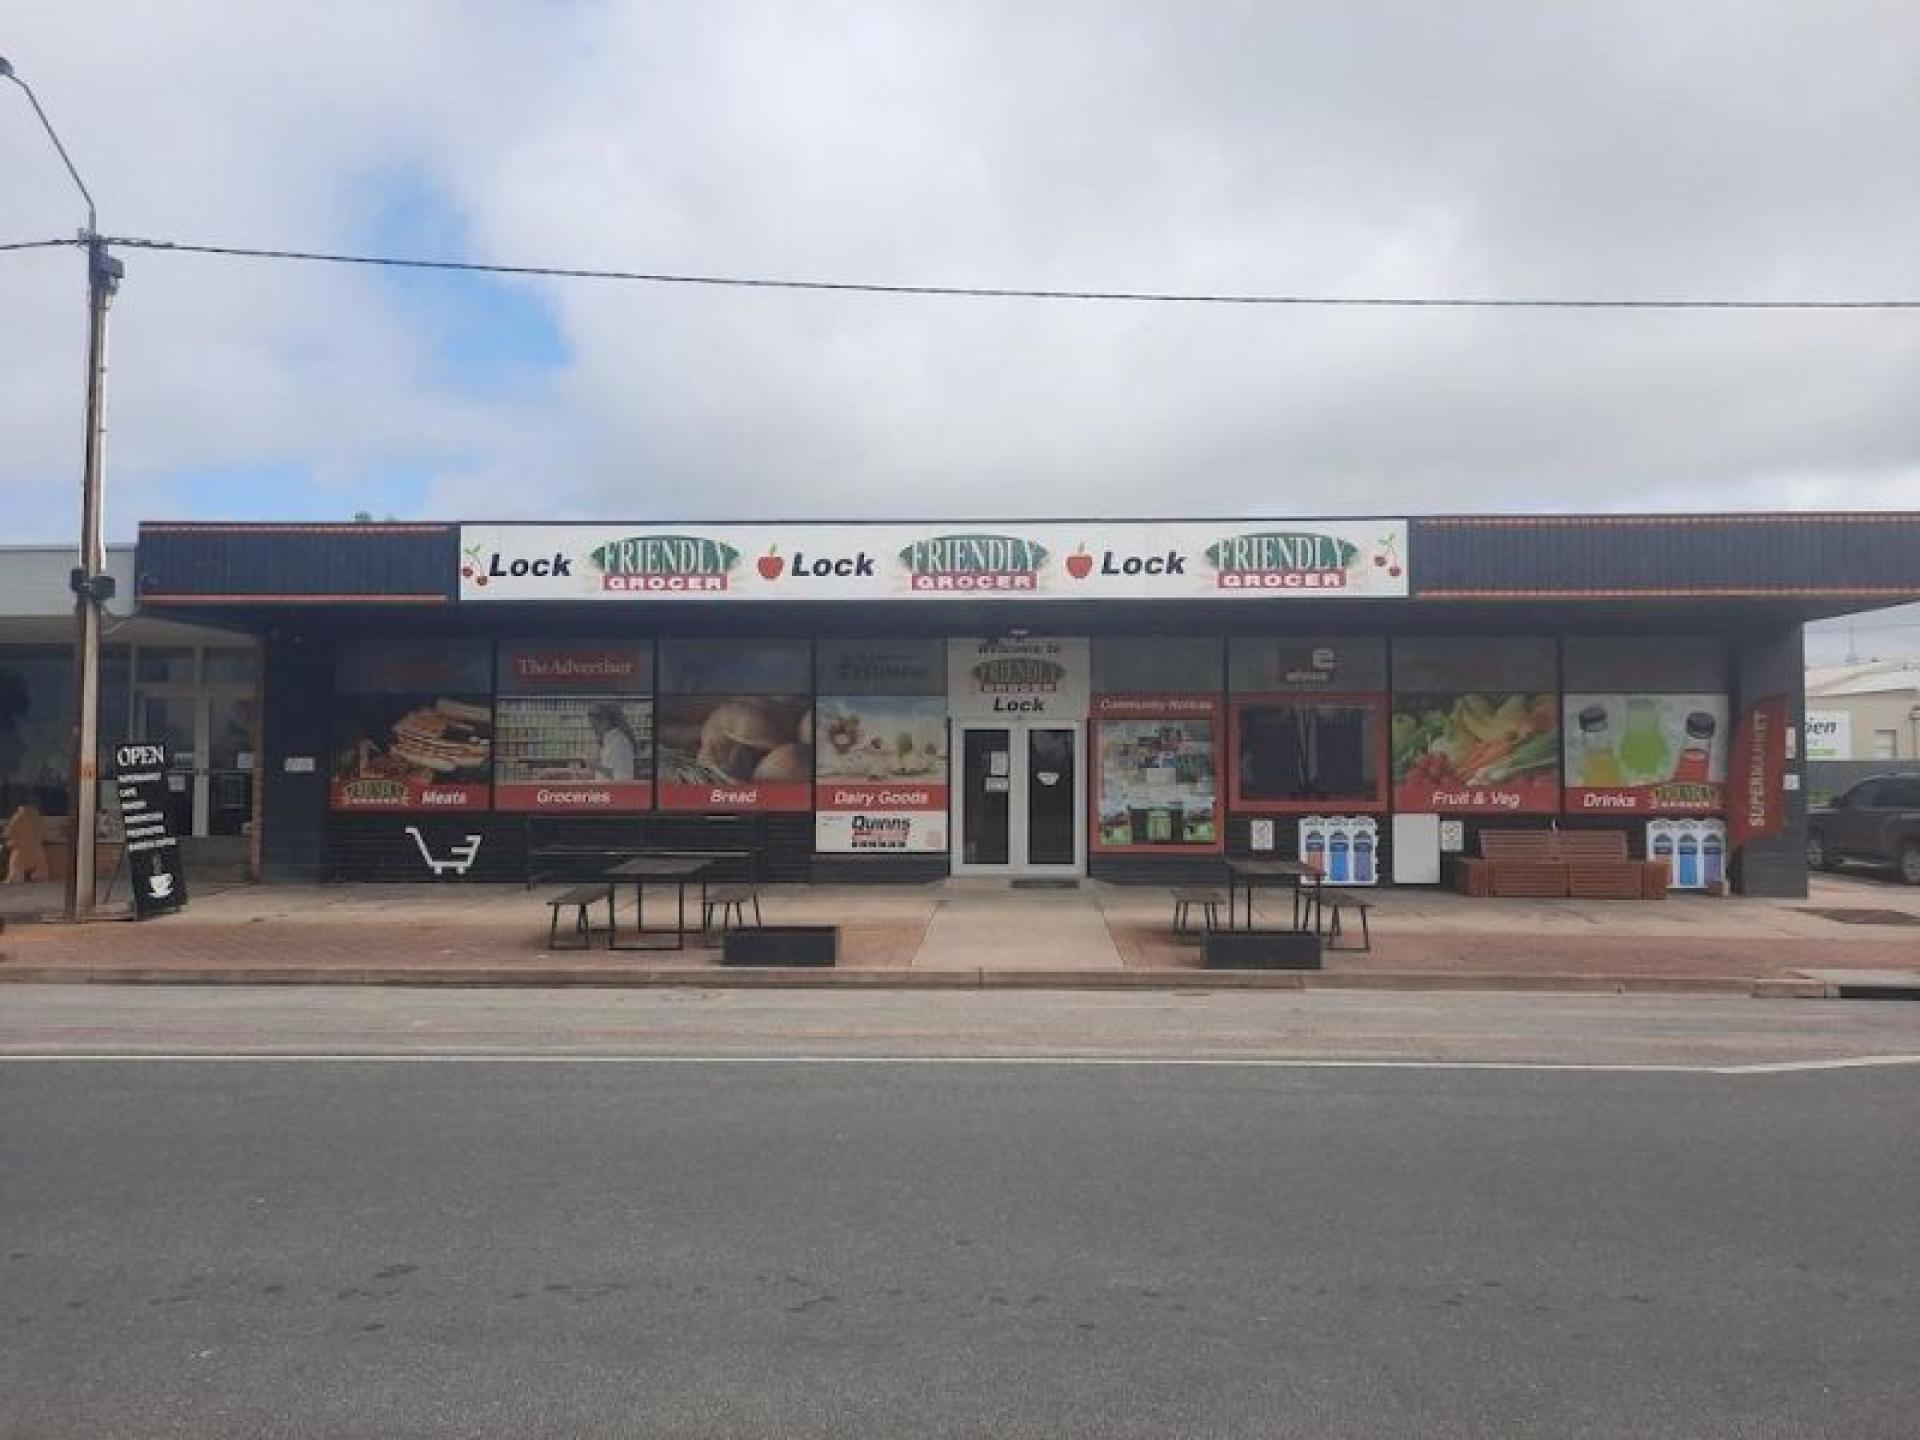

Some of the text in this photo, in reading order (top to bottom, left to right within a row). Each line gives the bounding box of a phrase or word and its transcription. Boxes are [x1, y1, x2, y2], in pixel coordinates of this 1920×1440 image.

[601, 538, 729, 575] FRIENDLY
[910, 538, 1037, 574] FRIENDLY
[1101, 550, 1187, 576] Lock
[1218, 537, 1347, 571] FRIENDLY
[489, 551, 573, 577] Lock
[791, 551, 875, 577] Lock
[607, 576, 723, 590] GROCER
[916, 575, 1033, 590] GROCER
[1223, 573, 1342, 588] GROCER
[993, 697, 1045, 712] Lock
[116, 745, 164, 767] OPEN
[422, 789, 467, 805] Meats
[536, 789, 611, 806] Groceries
[710, 788, 757, 803] Bread
[834, 790, 929, 808] Dairy Goods
[1432, 790, 1520, 808] Fruit & Veg
[1583, 792, 1637, 808] Drinks
